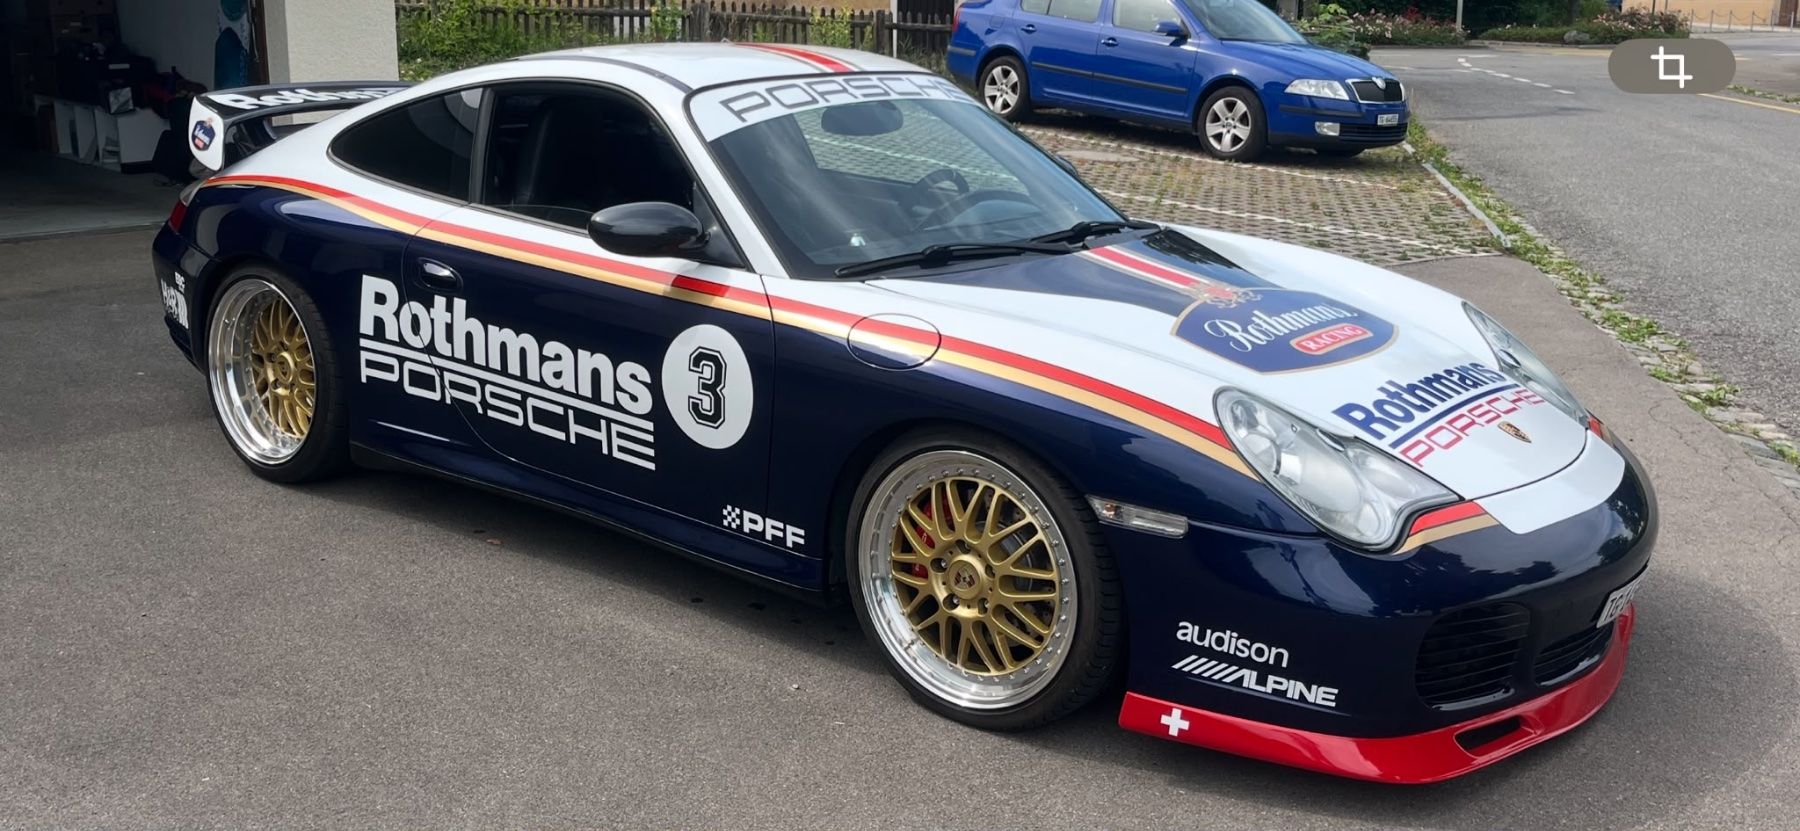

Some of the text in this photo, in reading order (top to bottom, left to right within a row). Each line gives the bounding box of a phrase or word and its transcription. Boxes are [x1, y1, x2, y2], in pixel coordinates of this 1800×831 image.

[719, 77, 970, 123] PORSCHE
[359, 274, 653, 415] Rothmans
[1204, 303, 1358, 352] Rothmans
[1301, 325, 1362, 350] RACING
[360, 350, 656, 471] PORSCHE
[688, 346, 728, 430] 3
[1331, 362, 1507, 441] Rothmans
[1399, 388, 1546, 468] PORSCHE
[743, 509, 805, 549] PFF
[1176, 621, 1289, 668] audison
